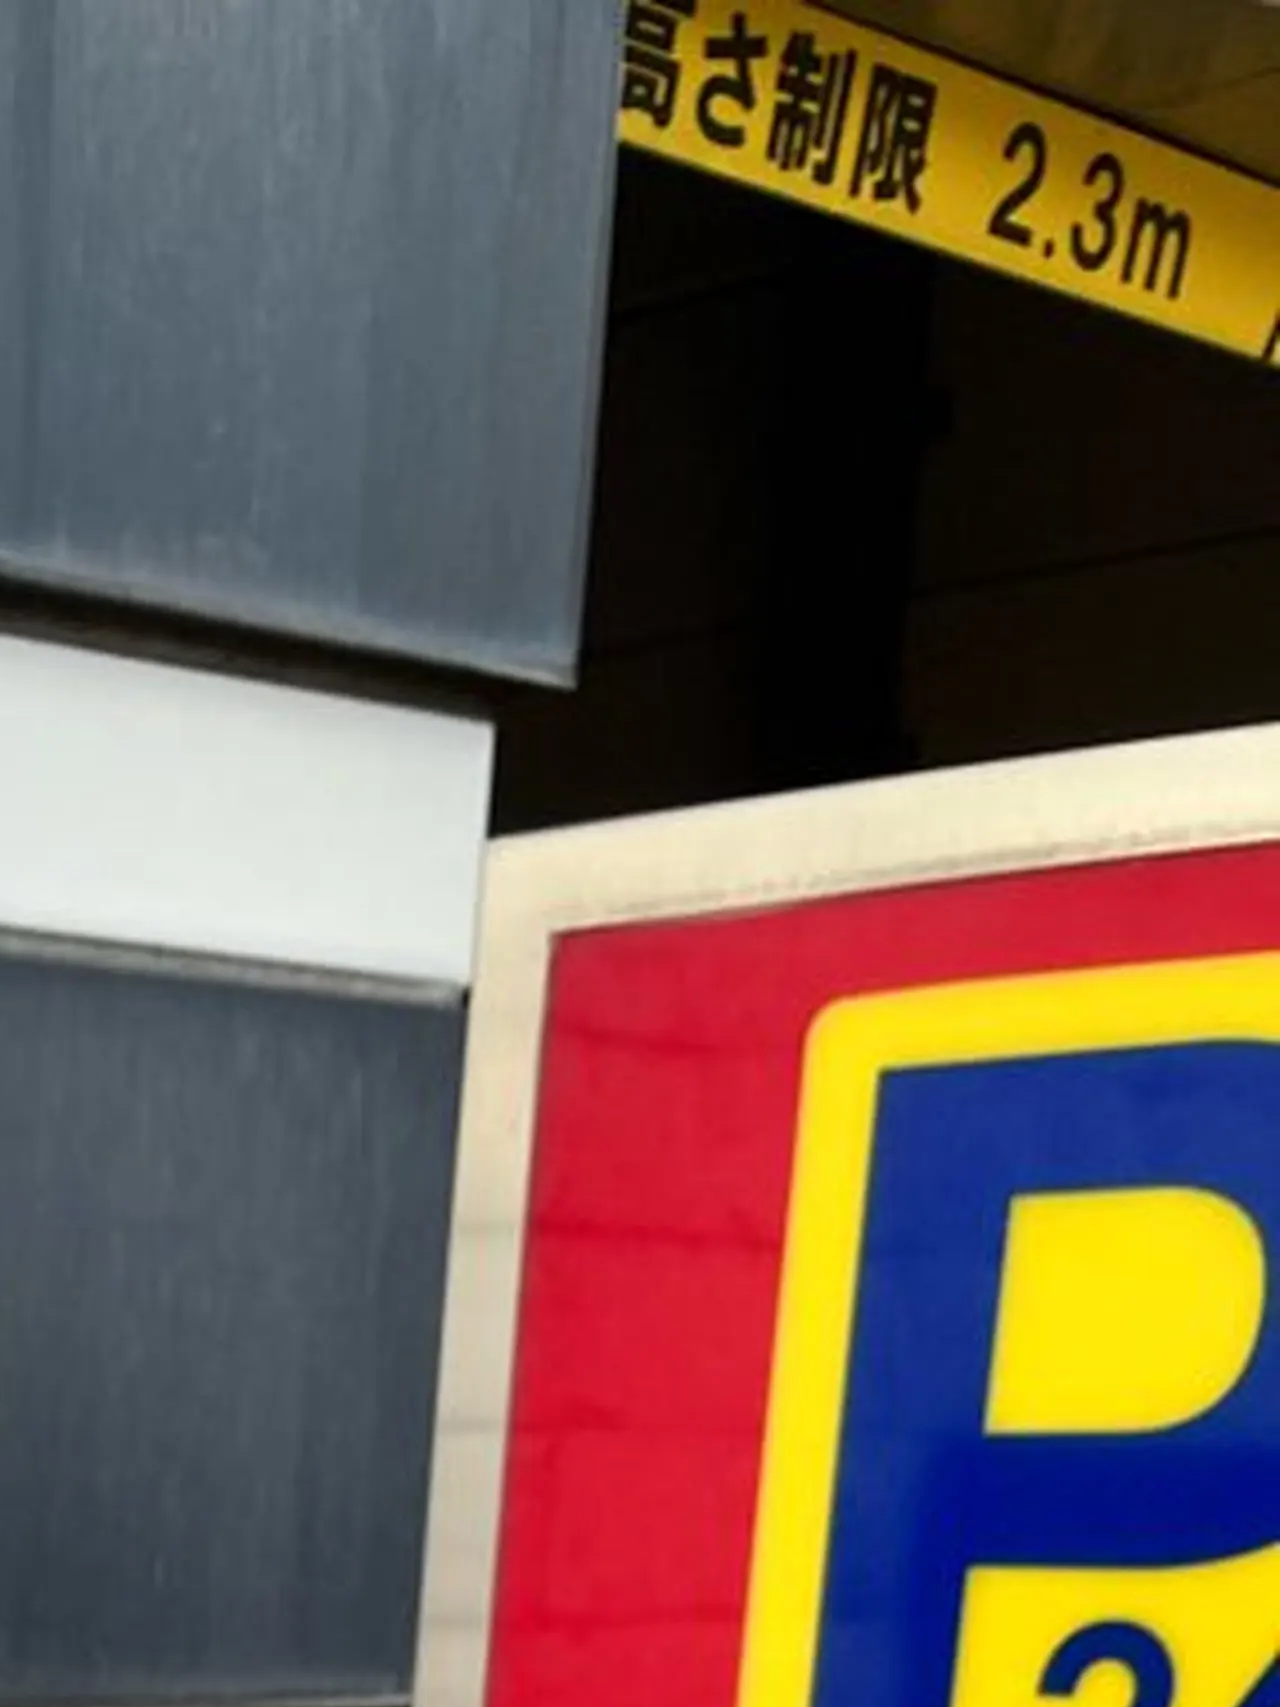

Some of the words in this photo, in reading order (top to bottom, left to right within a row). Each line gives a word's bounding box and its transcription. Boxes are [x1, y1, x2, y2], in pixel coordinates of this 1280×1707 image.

[621, 0, 936, 215] 高さ制限
[988, 121, 1191, 300] 2.3m
